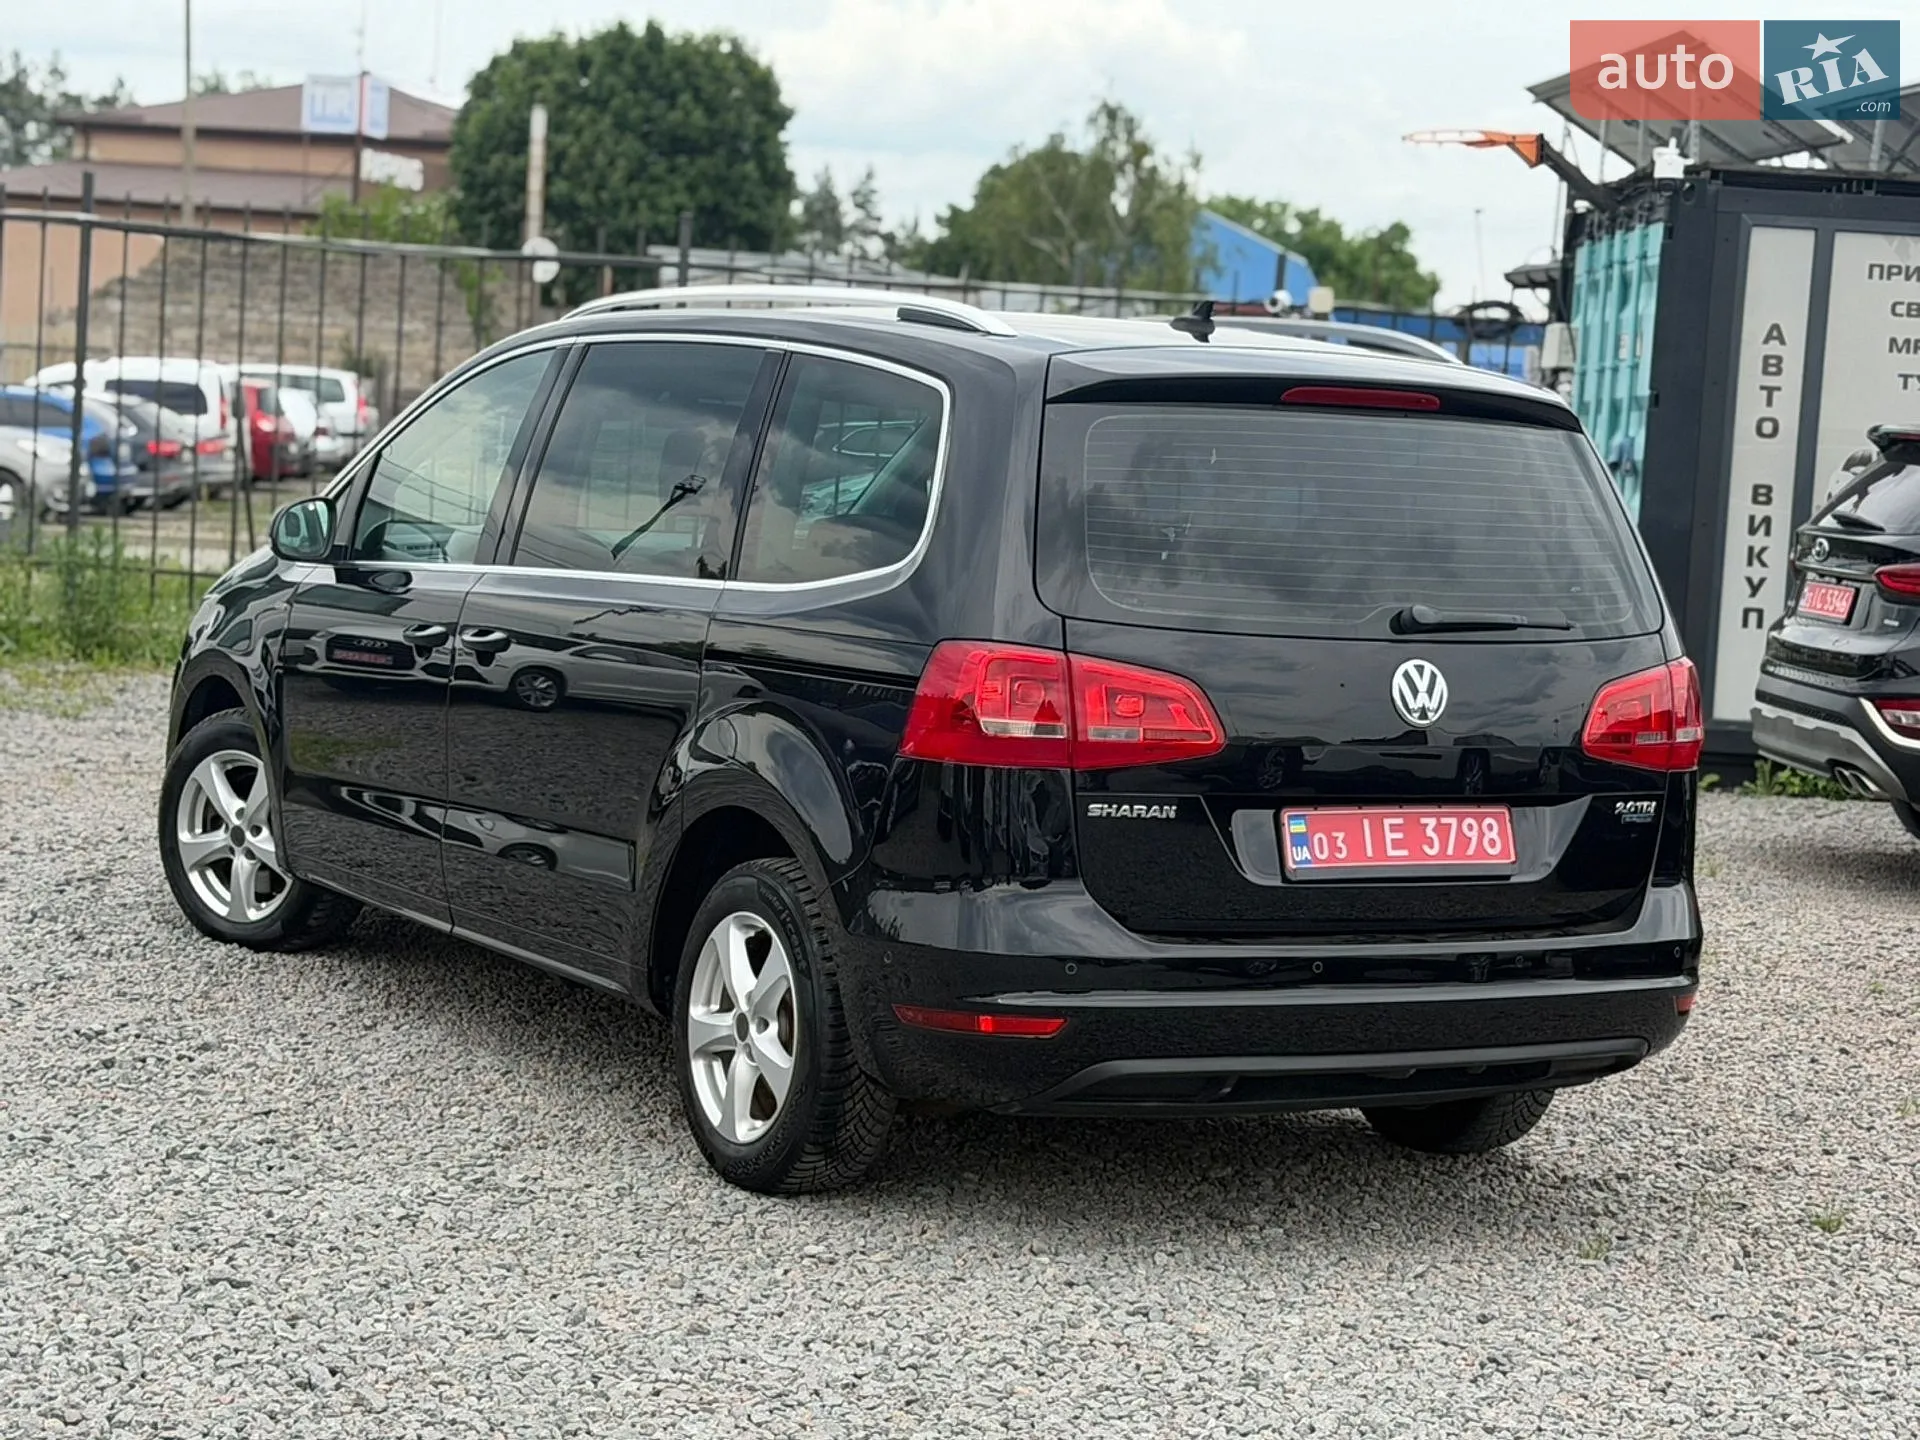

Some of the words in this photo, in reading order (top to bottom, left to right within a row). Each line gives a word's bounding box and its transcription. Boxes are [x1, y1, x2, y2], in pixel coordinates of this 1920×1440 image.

[1755, 323, 1787, 439] АВТО
[1741, 483, 1774, 629] ВИКУП
[1087, 803, 1177, 818] SHARAN
[1292, 845, 1311, 861] UA
[1313, 832, 1348, 860] 03
[1419, 816, 1501, 857] 3798
